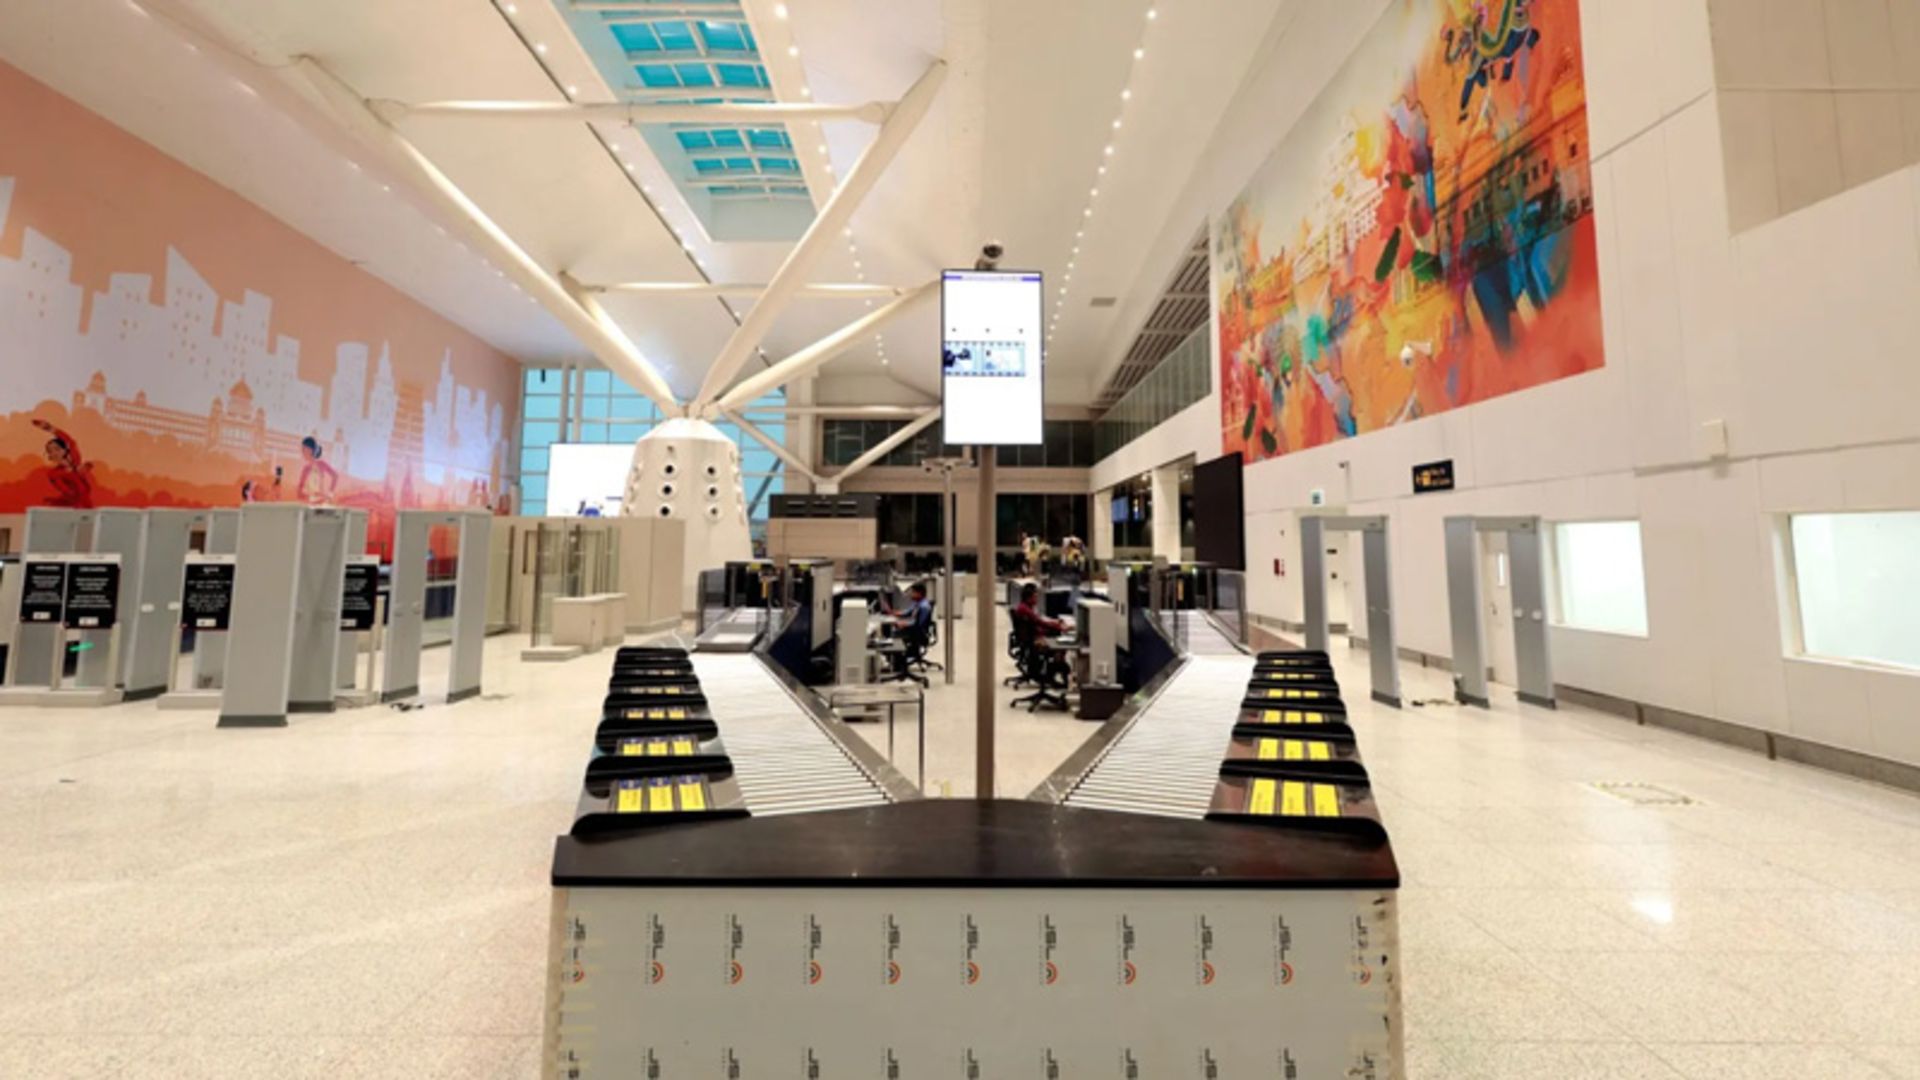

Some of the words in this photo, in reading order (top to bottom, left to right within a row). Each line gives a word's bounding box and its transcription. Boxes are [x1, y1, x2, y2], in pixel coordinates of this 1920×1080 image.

[653, 914, 664, 960] JSL
[731, 915, 742, 960] JSL
[810, 915, 821, 960] JSL
[888, 915, 900, 960] JSL
[967, 915, 978, 960] JSL
[1045, 915, 1056, 960] JSL
[1123, 915, 1134, 960] JSL
[1201, 916, 1212, 960] JSL
[1279, 916, 1291, 961] JSL
